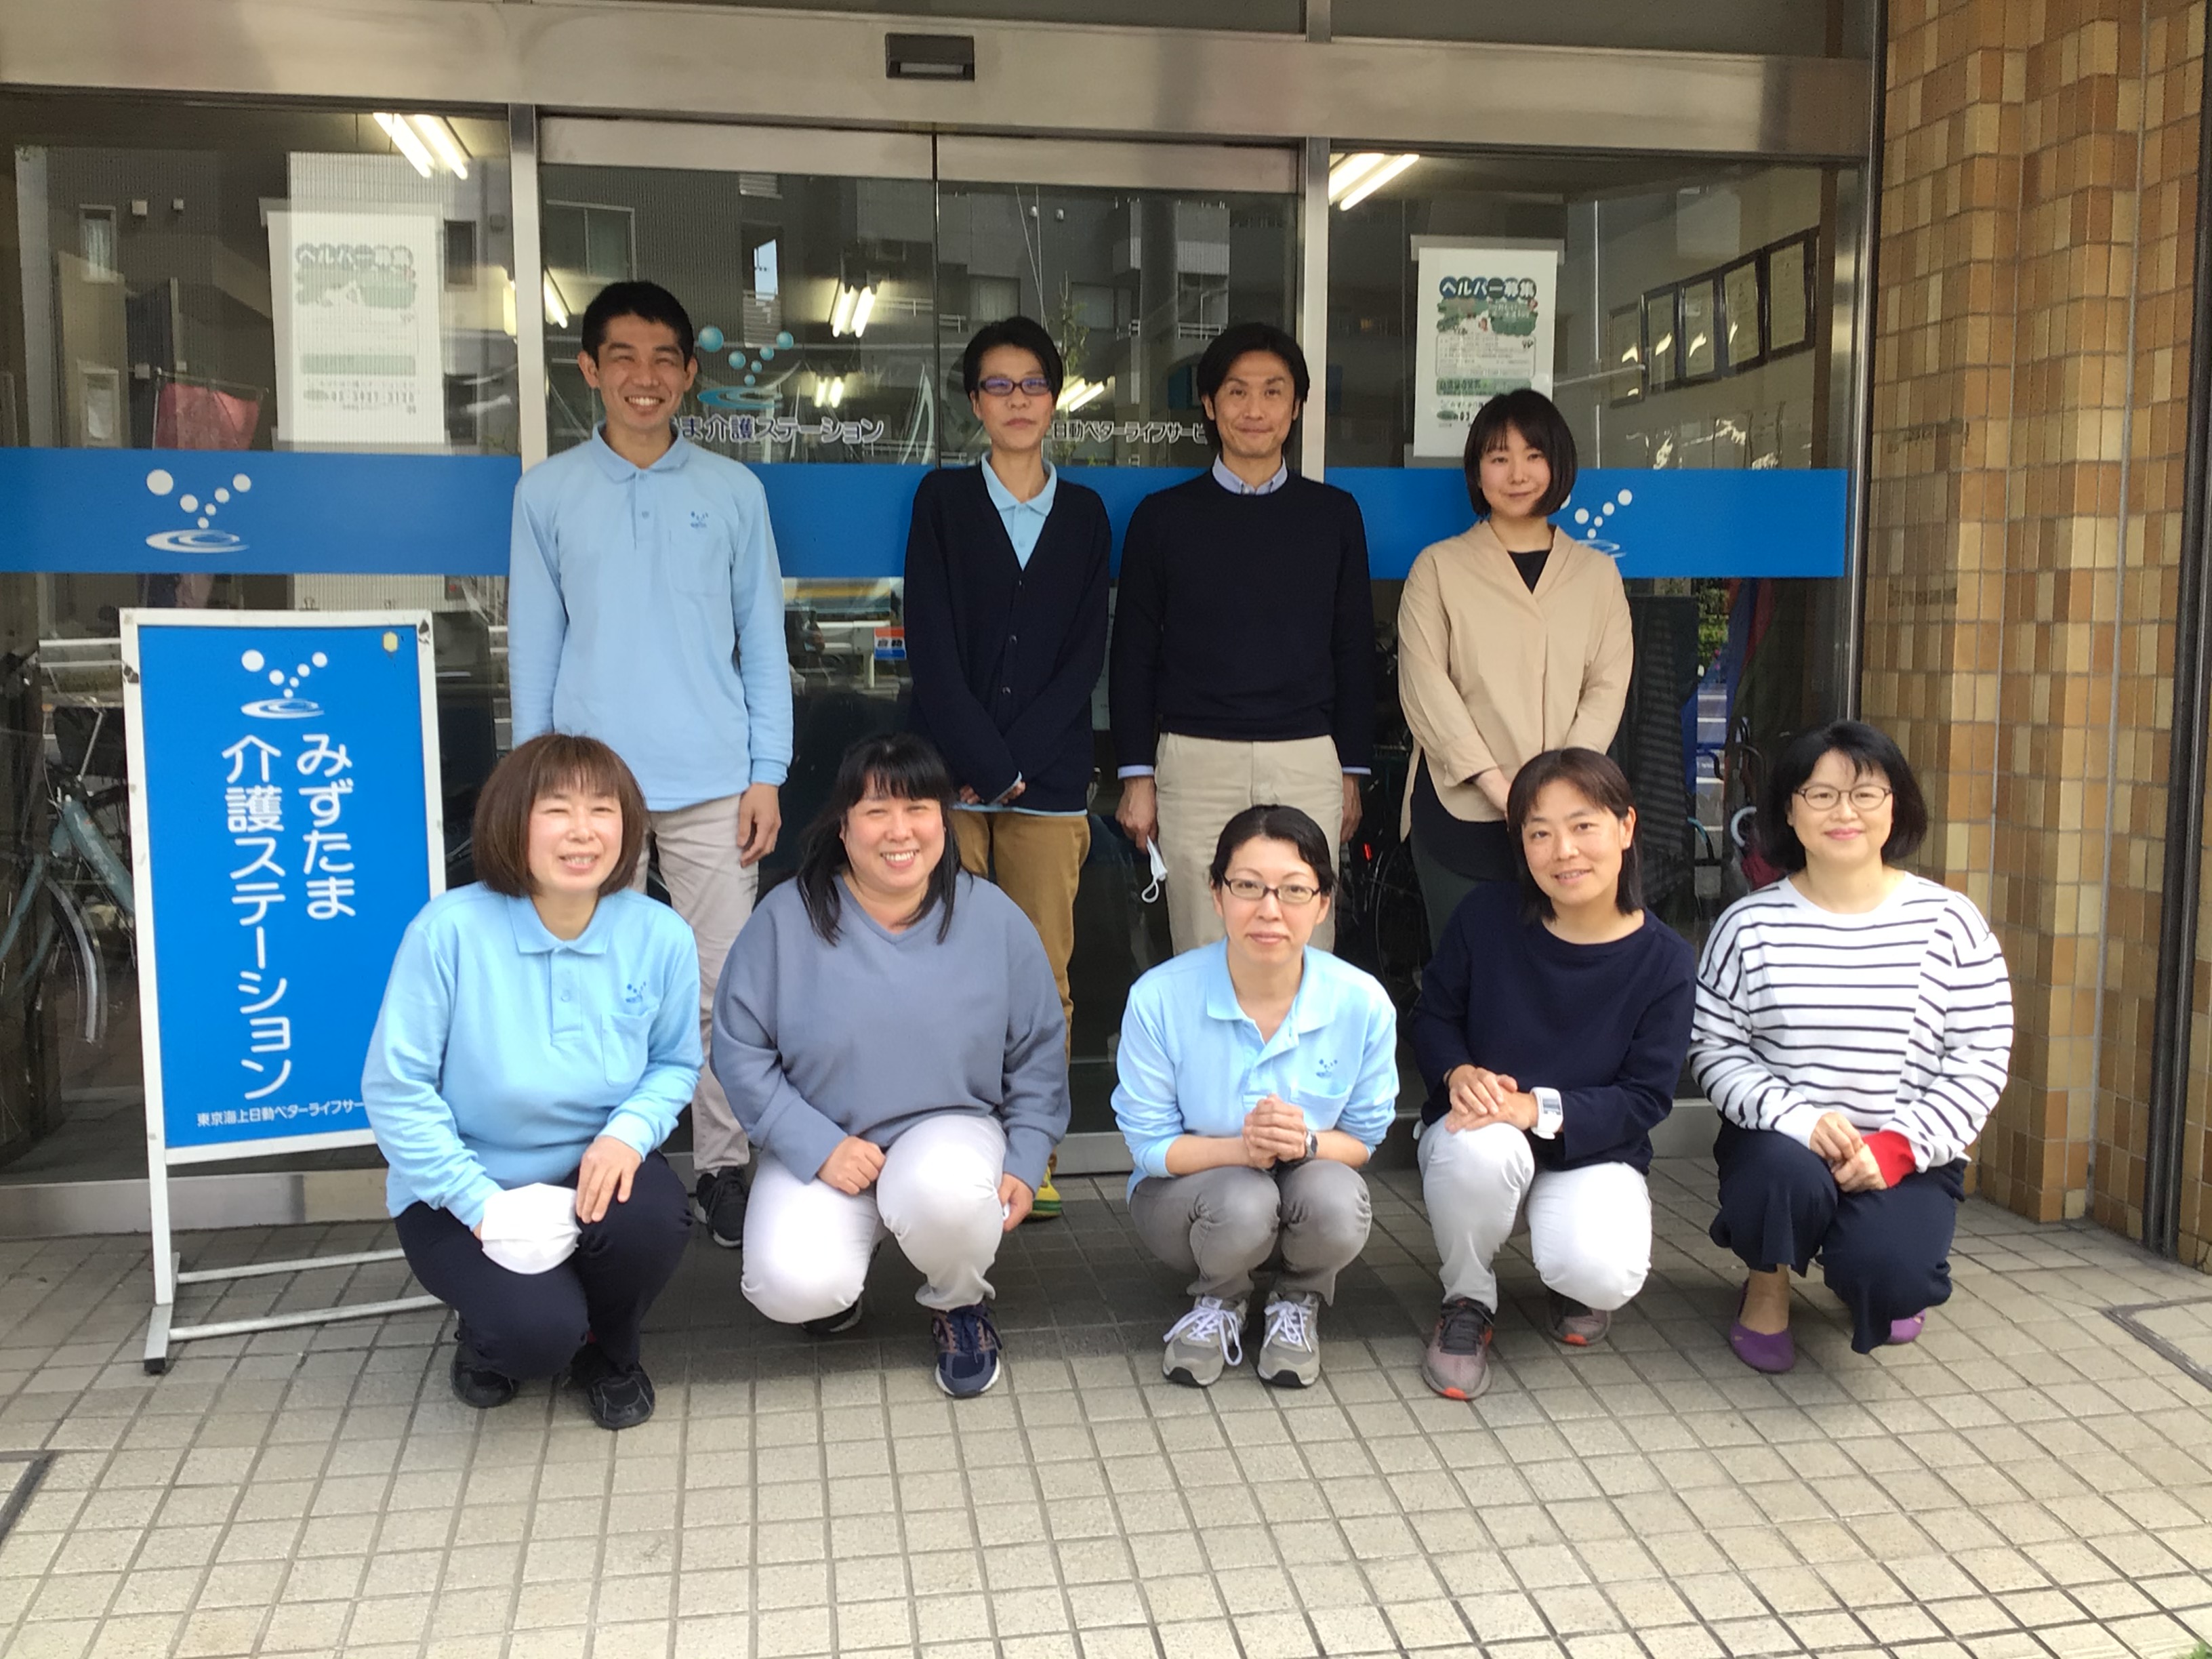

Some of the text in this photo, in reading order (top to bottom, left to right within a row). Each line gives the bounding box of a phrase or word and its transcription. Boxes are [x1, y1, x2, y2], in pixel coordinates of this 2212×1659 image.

[672, 413, 884, 443] ま介護ステーション
[296, 733, 356, 921] みずたま
[222, 733, 291, 1101] 介護ステーション
[197, 1099, 365, 1128] 東京海上日動ベターライフサー
